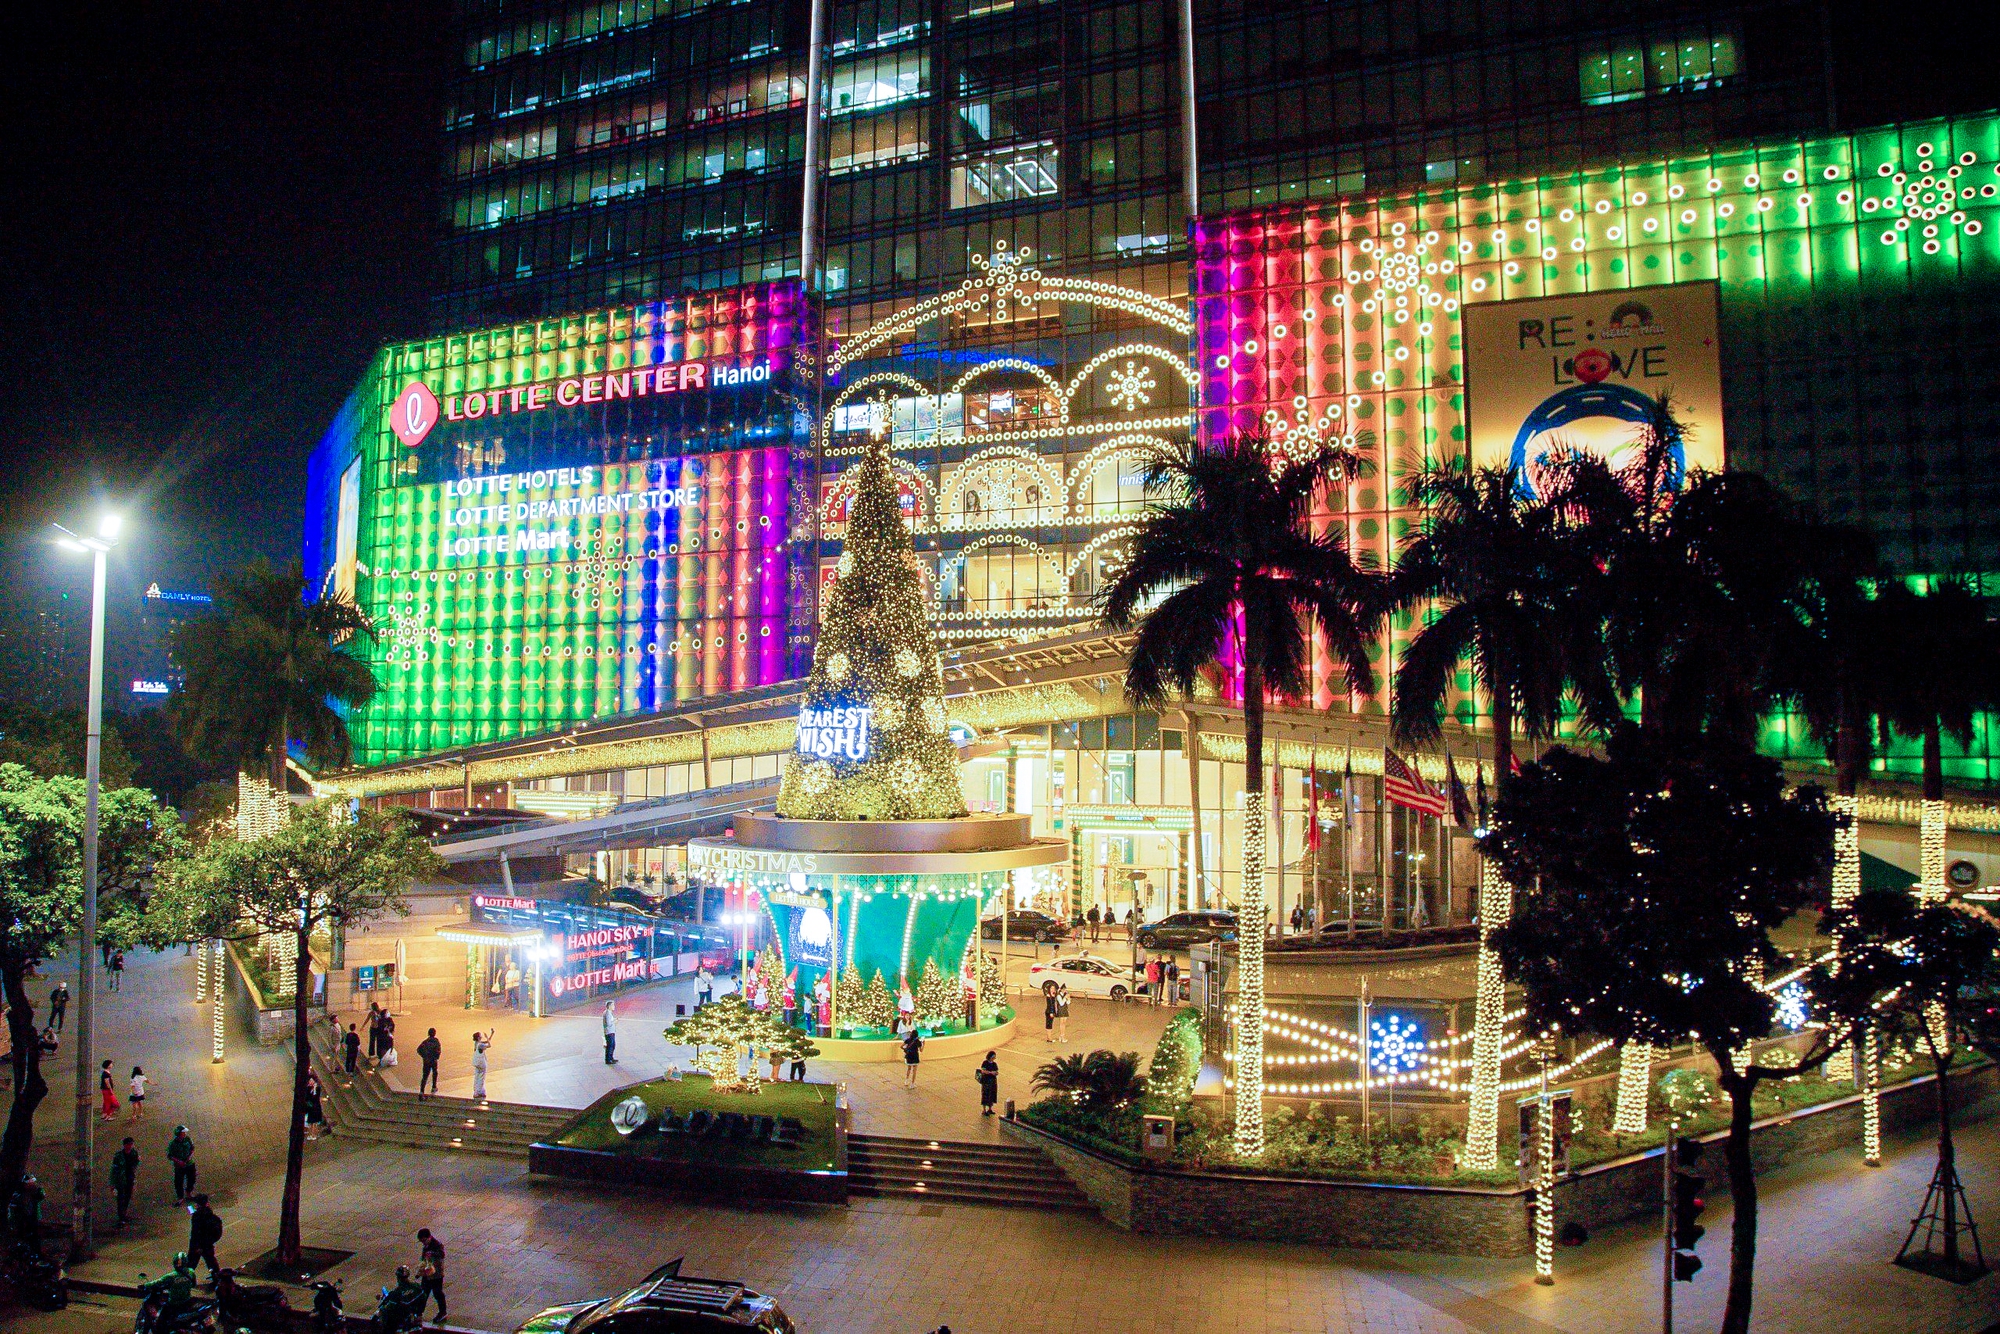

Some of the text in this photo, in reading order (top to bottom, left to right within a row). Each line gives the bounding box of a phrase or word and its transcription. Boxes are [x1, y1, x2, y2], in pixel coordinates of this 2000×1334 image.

[447, 360, 770, 422] LOTTE CENTER Hanoi
[446, 465, 593, 497] LOTTE HOTELS
[445, 486, 698, 526] LOTTE DEPARTMENT STORE
[444, 526, 570, 556] LOTTE Mart
[800, 706, 872, 743] DEAREST
[796, 726, 866, 760] WISH
[711, 848, 818, 873] CHRISTMAS
[484, 898, 536, 909] LOTTE Mart
[567, 929, 611, 950] HANOI
[614, 925, 641, 942] SKY
[567, 969, 611, 991] LOTTE
[613, 958, 646, 981] Mart
